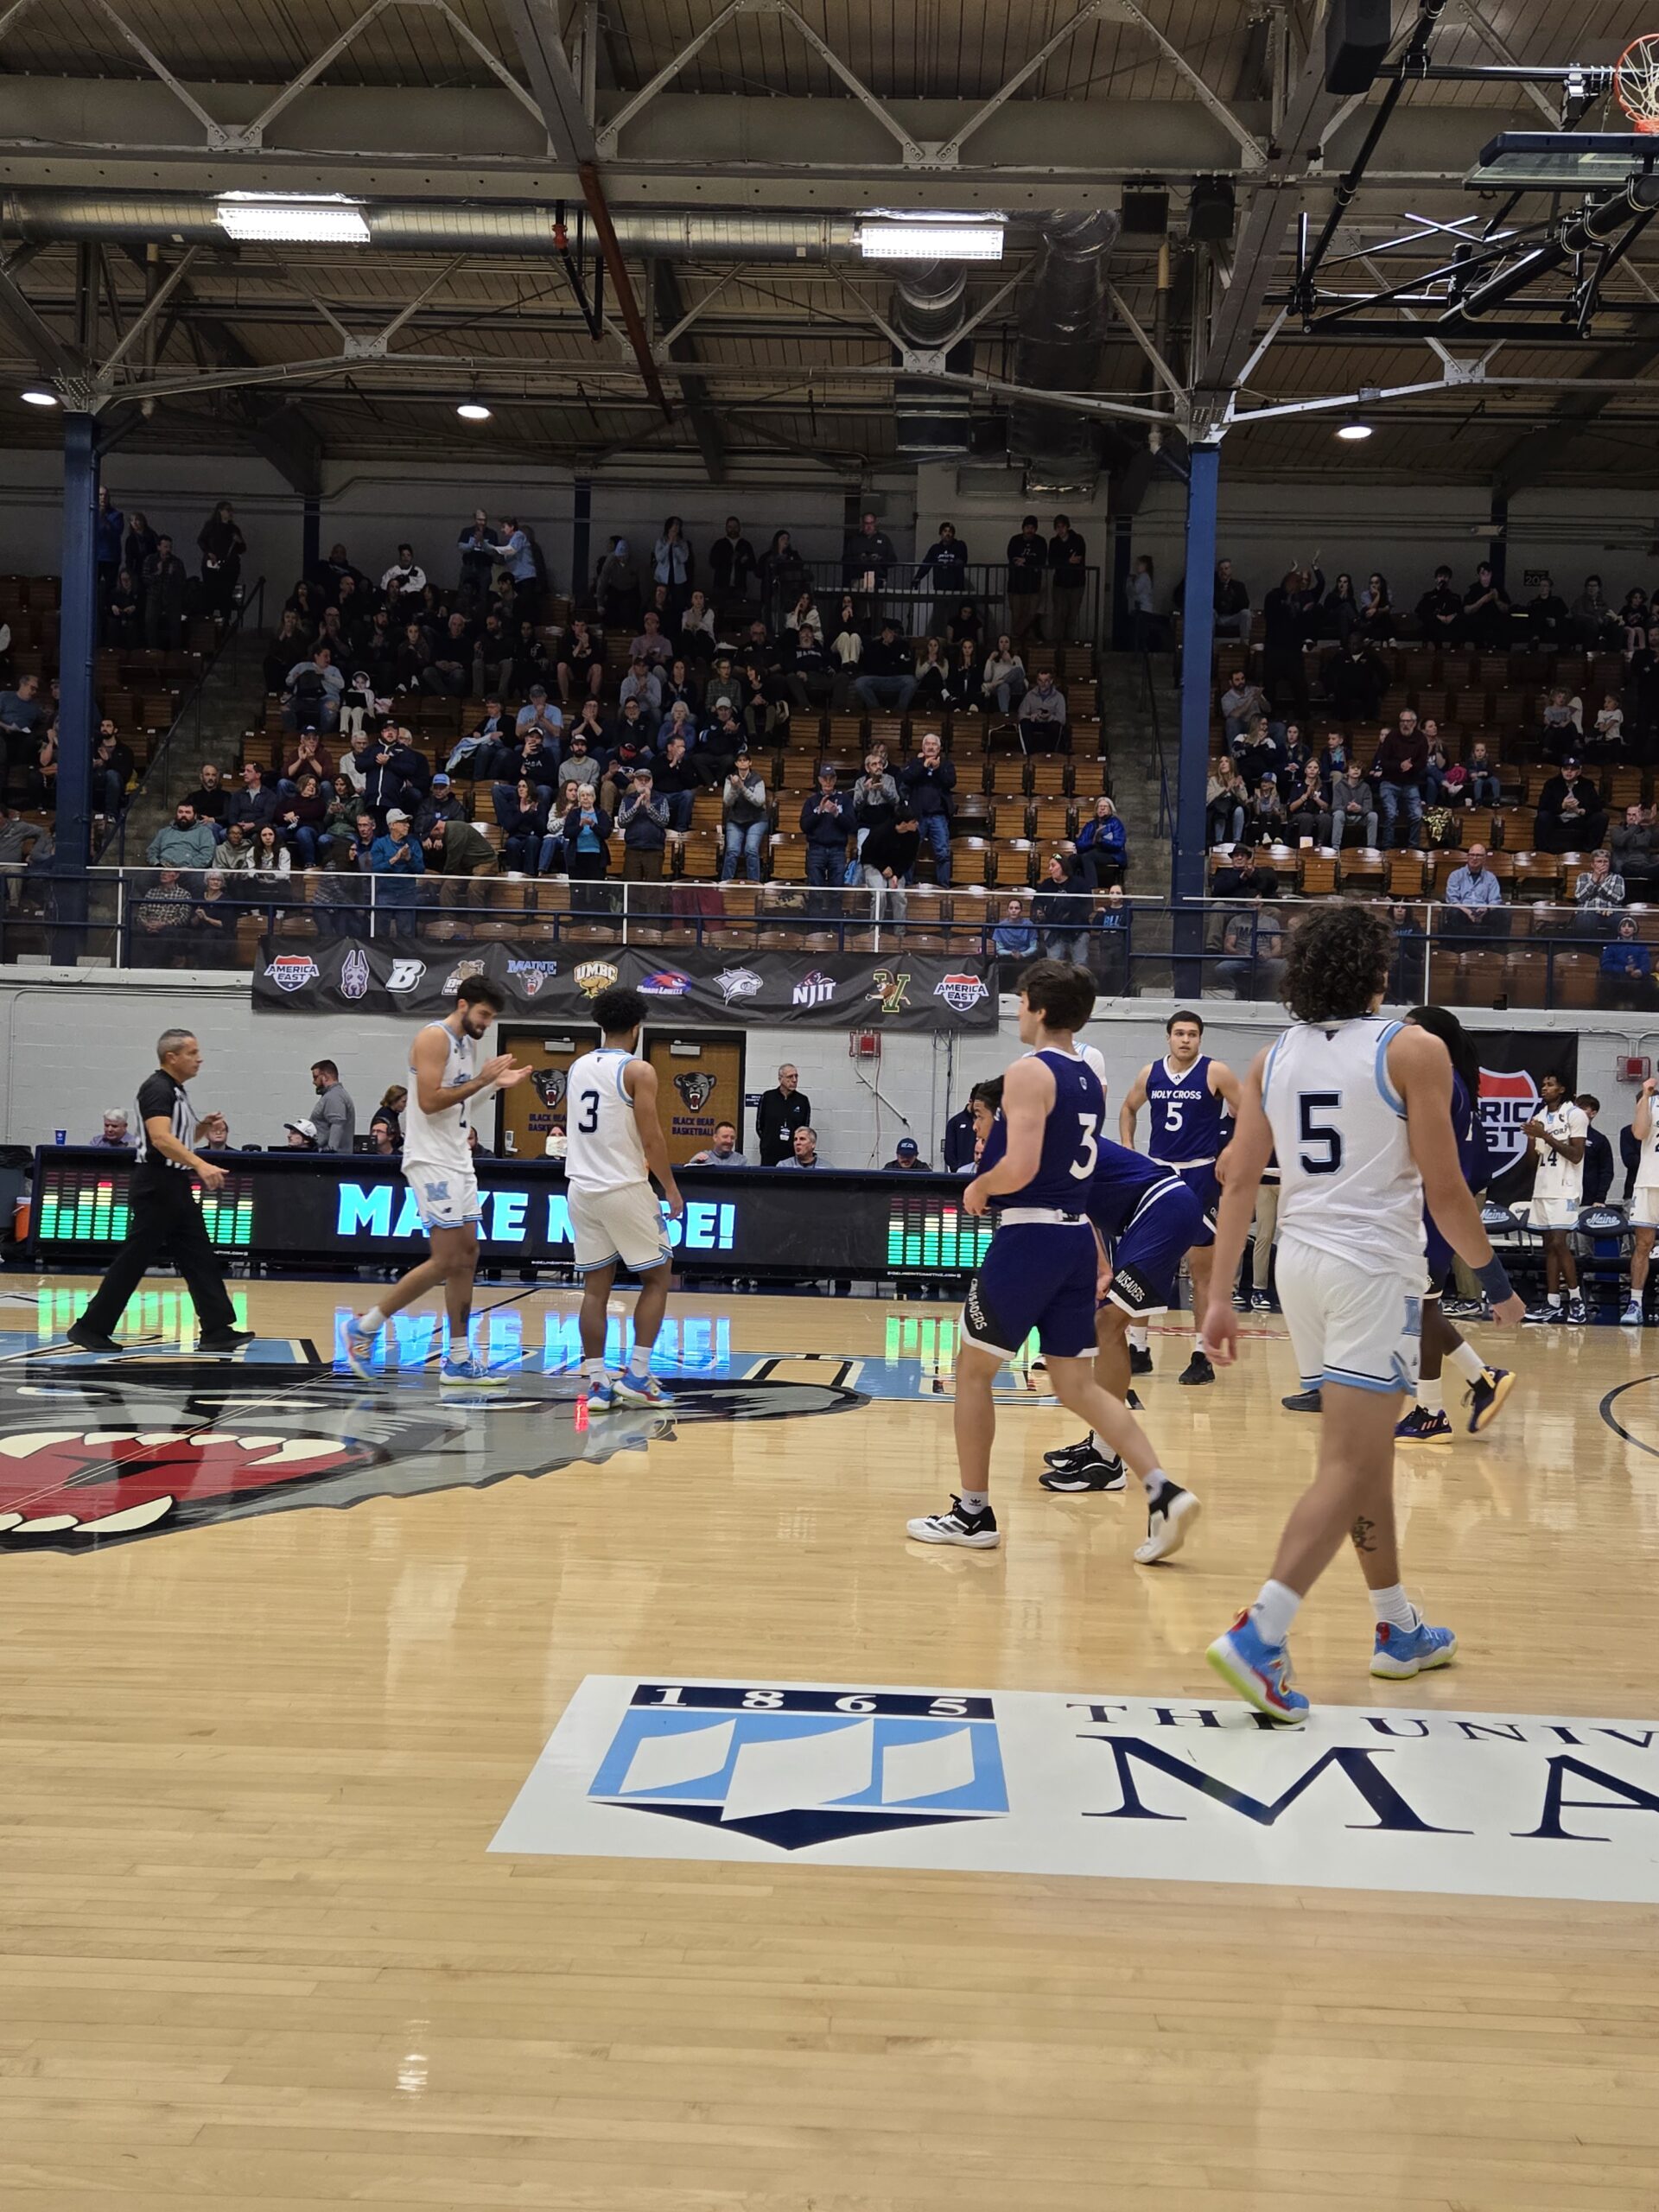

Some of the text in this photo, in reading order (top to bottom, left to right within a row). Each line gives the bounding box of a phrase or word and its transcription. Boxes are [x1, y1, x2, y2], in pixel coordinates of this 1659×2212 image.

[267, 965, 317, 975] AMERICA
[385, 959, 426, 993] B
[506, 960, 557, 976] MAINE
[575, 962, 617, 982] UMBC
[793, 982, 836, 1008] NJIT
[937, 984, 987, 995] AMERICA
[947, 991, 975, 1001] EAST
[1151, 1090, 1202, 1100] HOLY CROSS
[529, 1113, 551, 1122] BLACK
[578, 1090, 599, 1134] 3
[1165, 1102, 1183, 1131] 5
[1297, 1090, 1344, 1176] 5
[1069, 1113, 1098, 1180] 3
[337, 1183, 527, 1242] MAE
[1586, 1212, 1620, 1227] Maine
[969, 1278, 988, 1330] CRUSADERS
